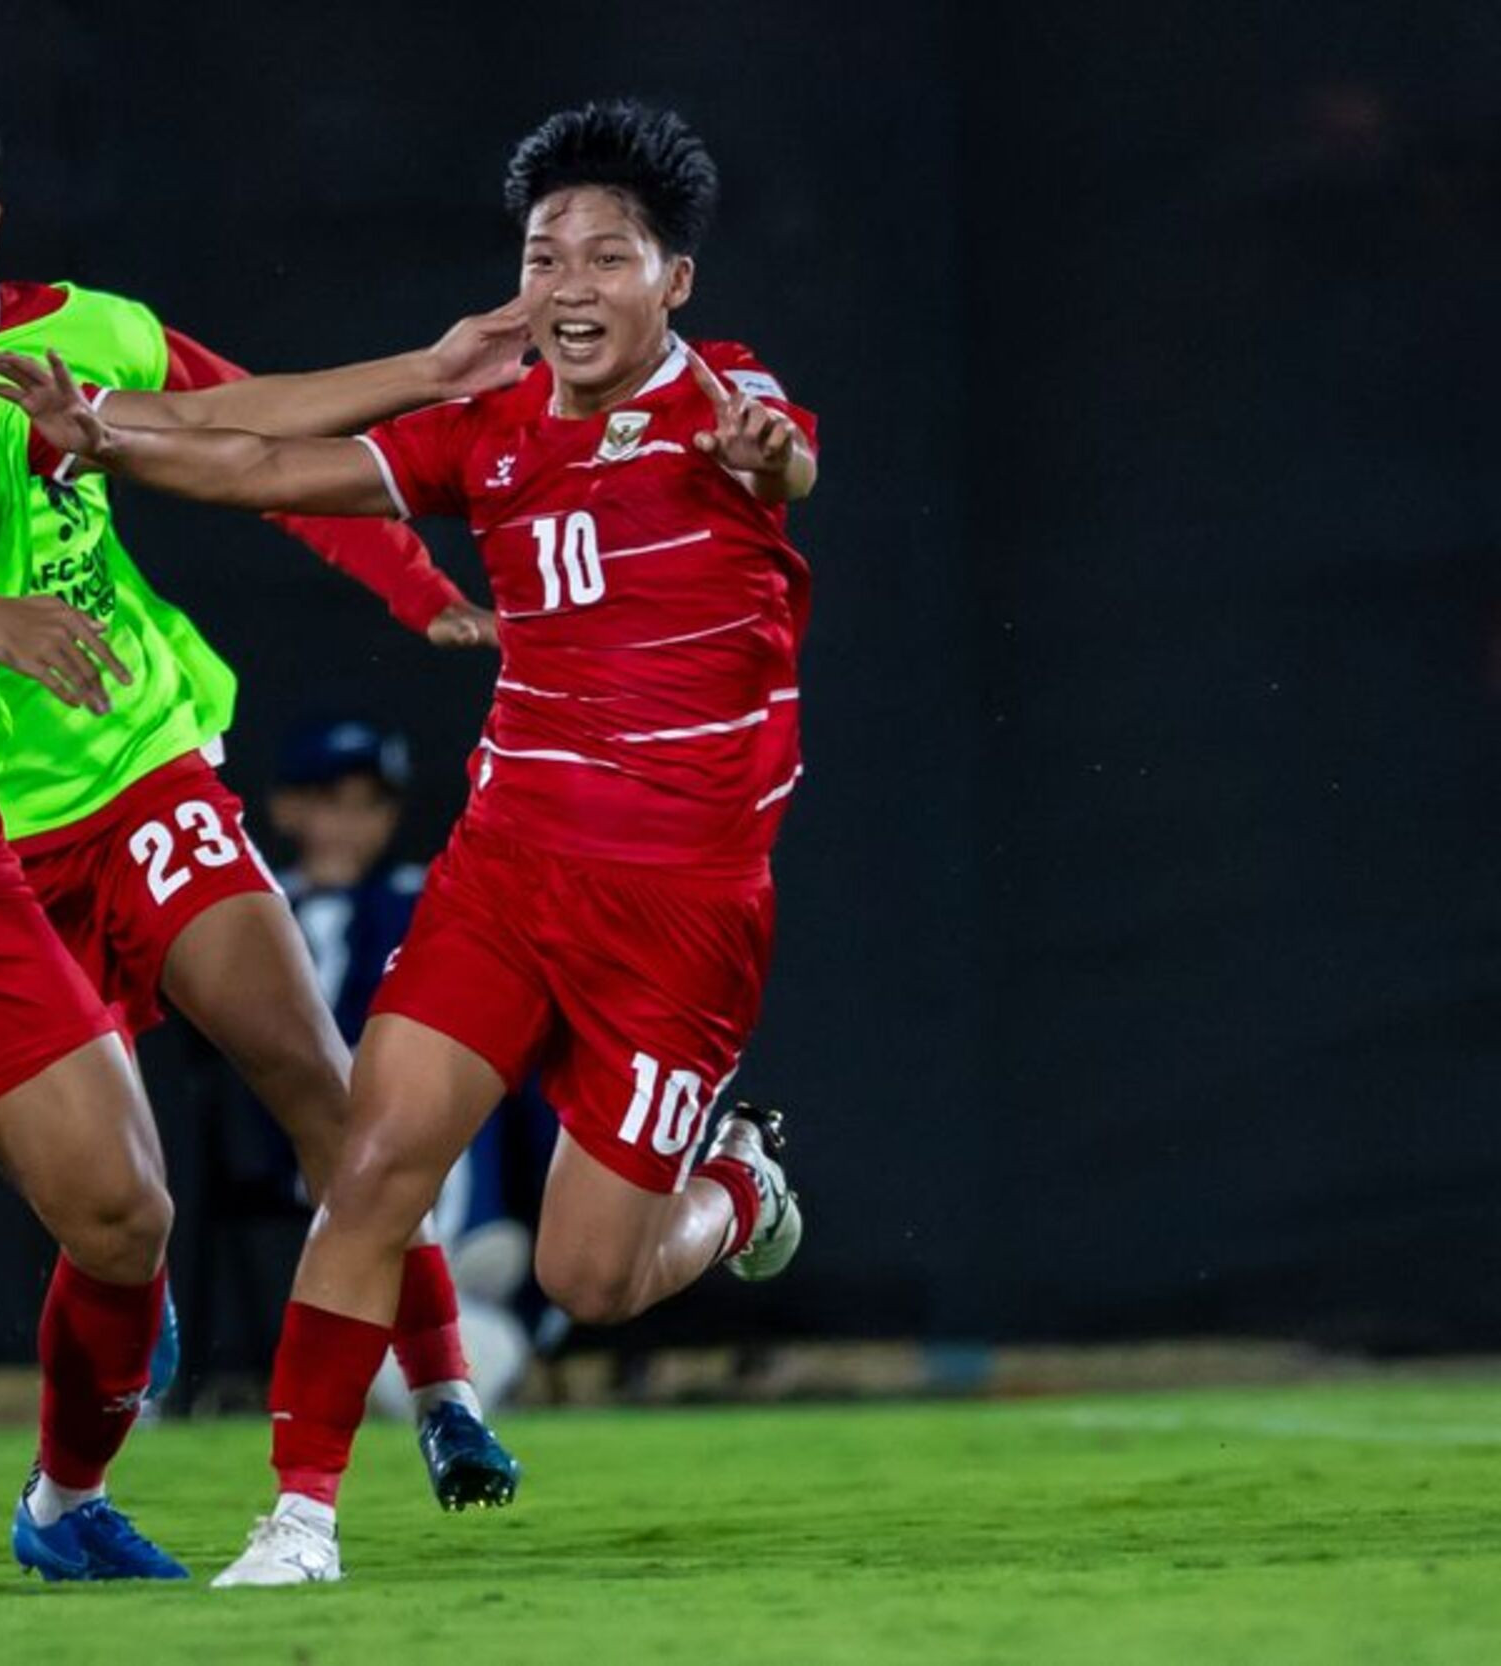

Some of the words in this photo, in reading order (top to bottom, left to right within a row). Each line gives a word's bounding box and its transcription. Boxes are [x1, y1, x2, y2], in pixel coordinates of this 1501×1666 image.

[532, 510, 605, 611] 10
[129, 800, 238, 906] 23
[618, 1051, 701, 1155] 10
